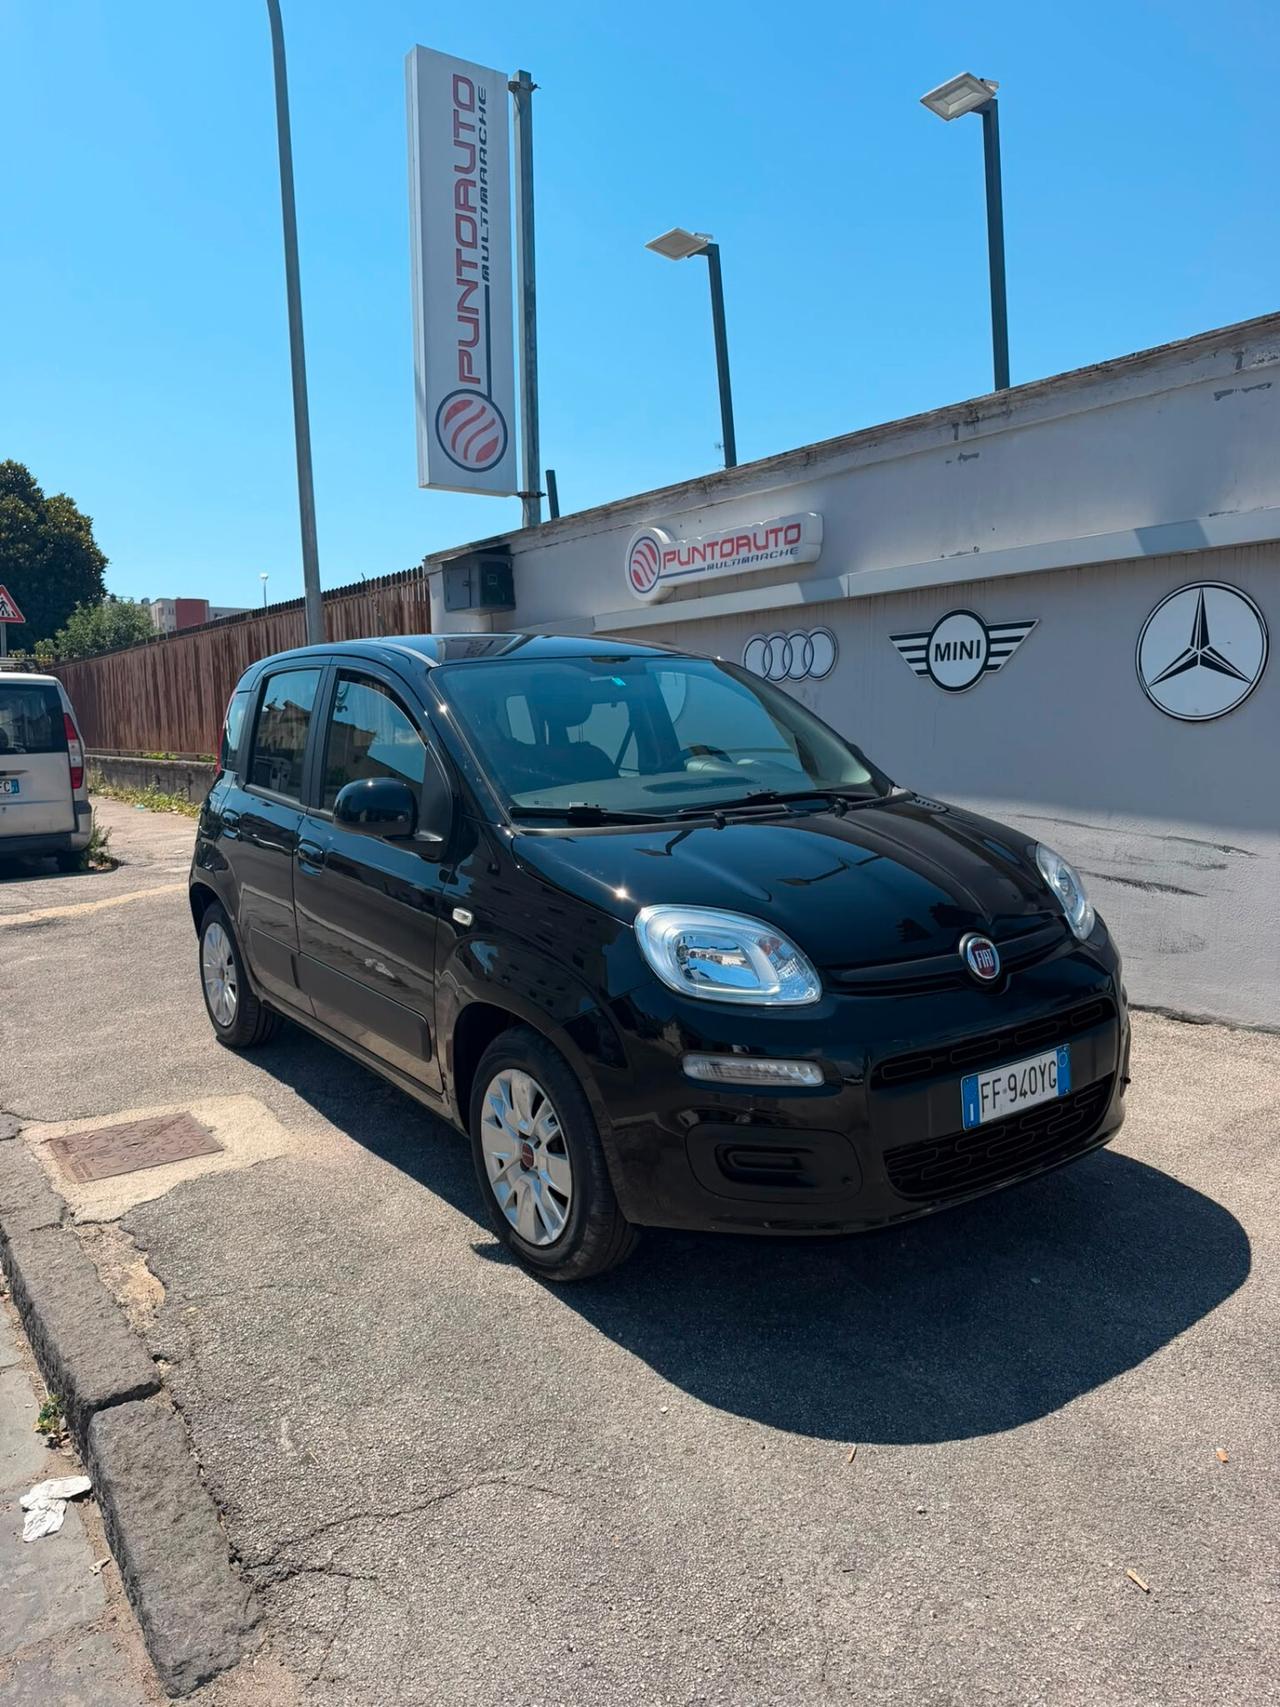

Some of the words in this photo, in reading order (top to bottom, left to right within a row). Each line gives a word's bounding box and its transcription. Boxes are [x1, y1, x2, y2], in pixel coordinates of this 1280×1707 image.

[478, 85, 490, 282] MULTIMARCHE
[453, 73, 481, 385] PUNTOAUTO
[663, 523, 801, 570] PUNTOAUTO
[706, 547, 800, 571] MULTIMARCHE
[934, 639, 981, 662] MINI
[975, 949, 994, 968] FIAT
[980, 1078, 1001, 1118] FF
[1007, 1060, 1057, 1103] 940YG
